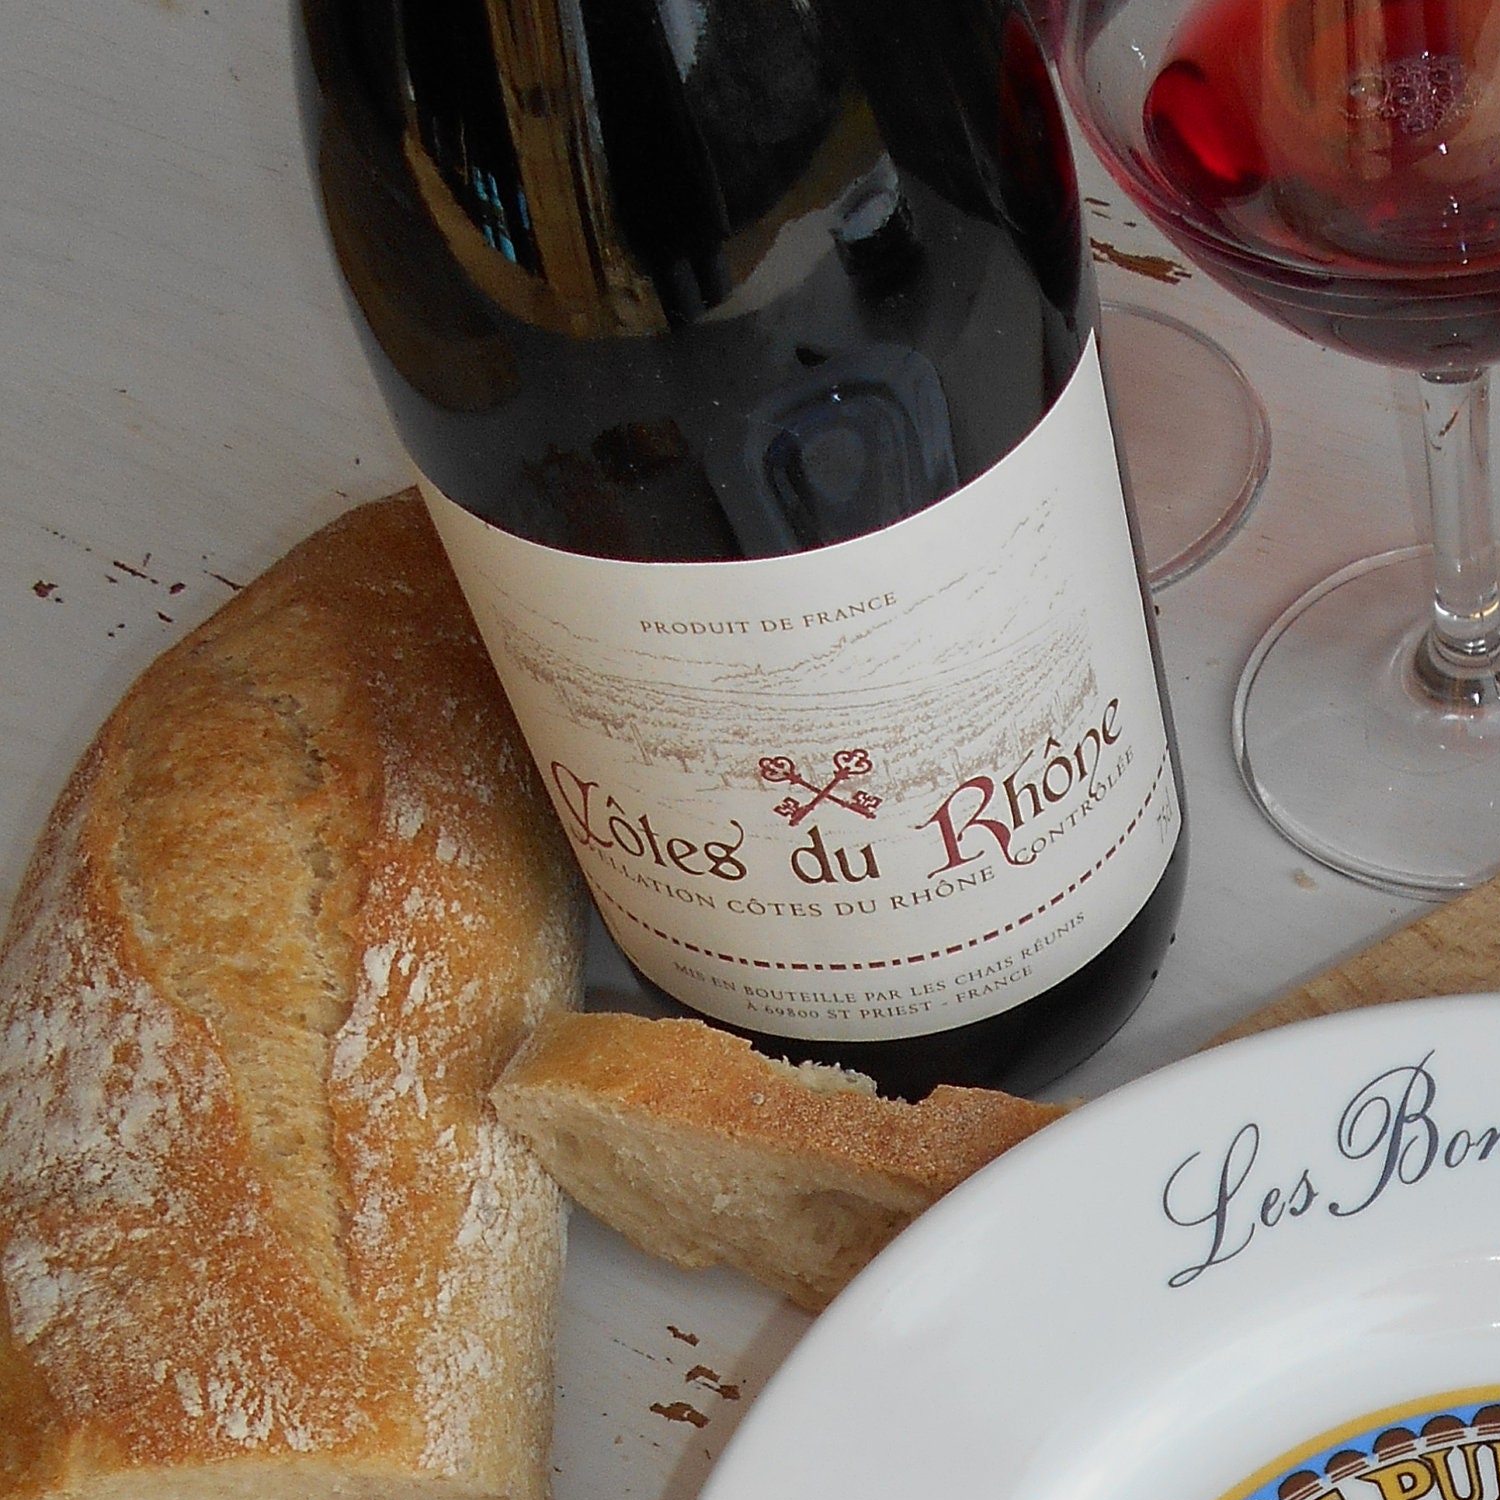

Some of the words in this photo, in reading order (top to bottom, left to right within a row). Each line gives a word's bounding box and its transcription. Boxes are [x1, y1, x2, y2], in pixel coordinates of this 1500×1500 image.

[640, 619, 749, 635] PRODUIT
[760, 617, 794, 633] DE
[803, 591, 897, 628] FRANCE
[551, 760, 748, 881] Côtes
[790, 825, 880, 884] du
[915, 698, 1122, 879] Rhône
[727, 898, 823, 918] CÔTES
[837, 899, 877, 917] DU
[890, 865, 996, 910] RHÔNE
[1014, 745, 1134, 865] CONTRÔLÉE
[672, 960, 706, 982] MIS
[711, 974, 737, 992] EN
[743, 984, 857, 1004] BOUTEILLE
[865, 989, 902, 1002] PAR
[909, 979, 947, 997] LES
[954, 956, 1015, 986] CHAIS
[1020, 911, 1087, 961] RÉUNIS
[764, 1004, 820, 1020] 69800
[827, 1008, 851, 1020] ST
[859, 1000, 933, 1020] PRIEST
[955, 964, 1033, 1003] FRANCE
[1162, 1122, 1320, 1289] Les
